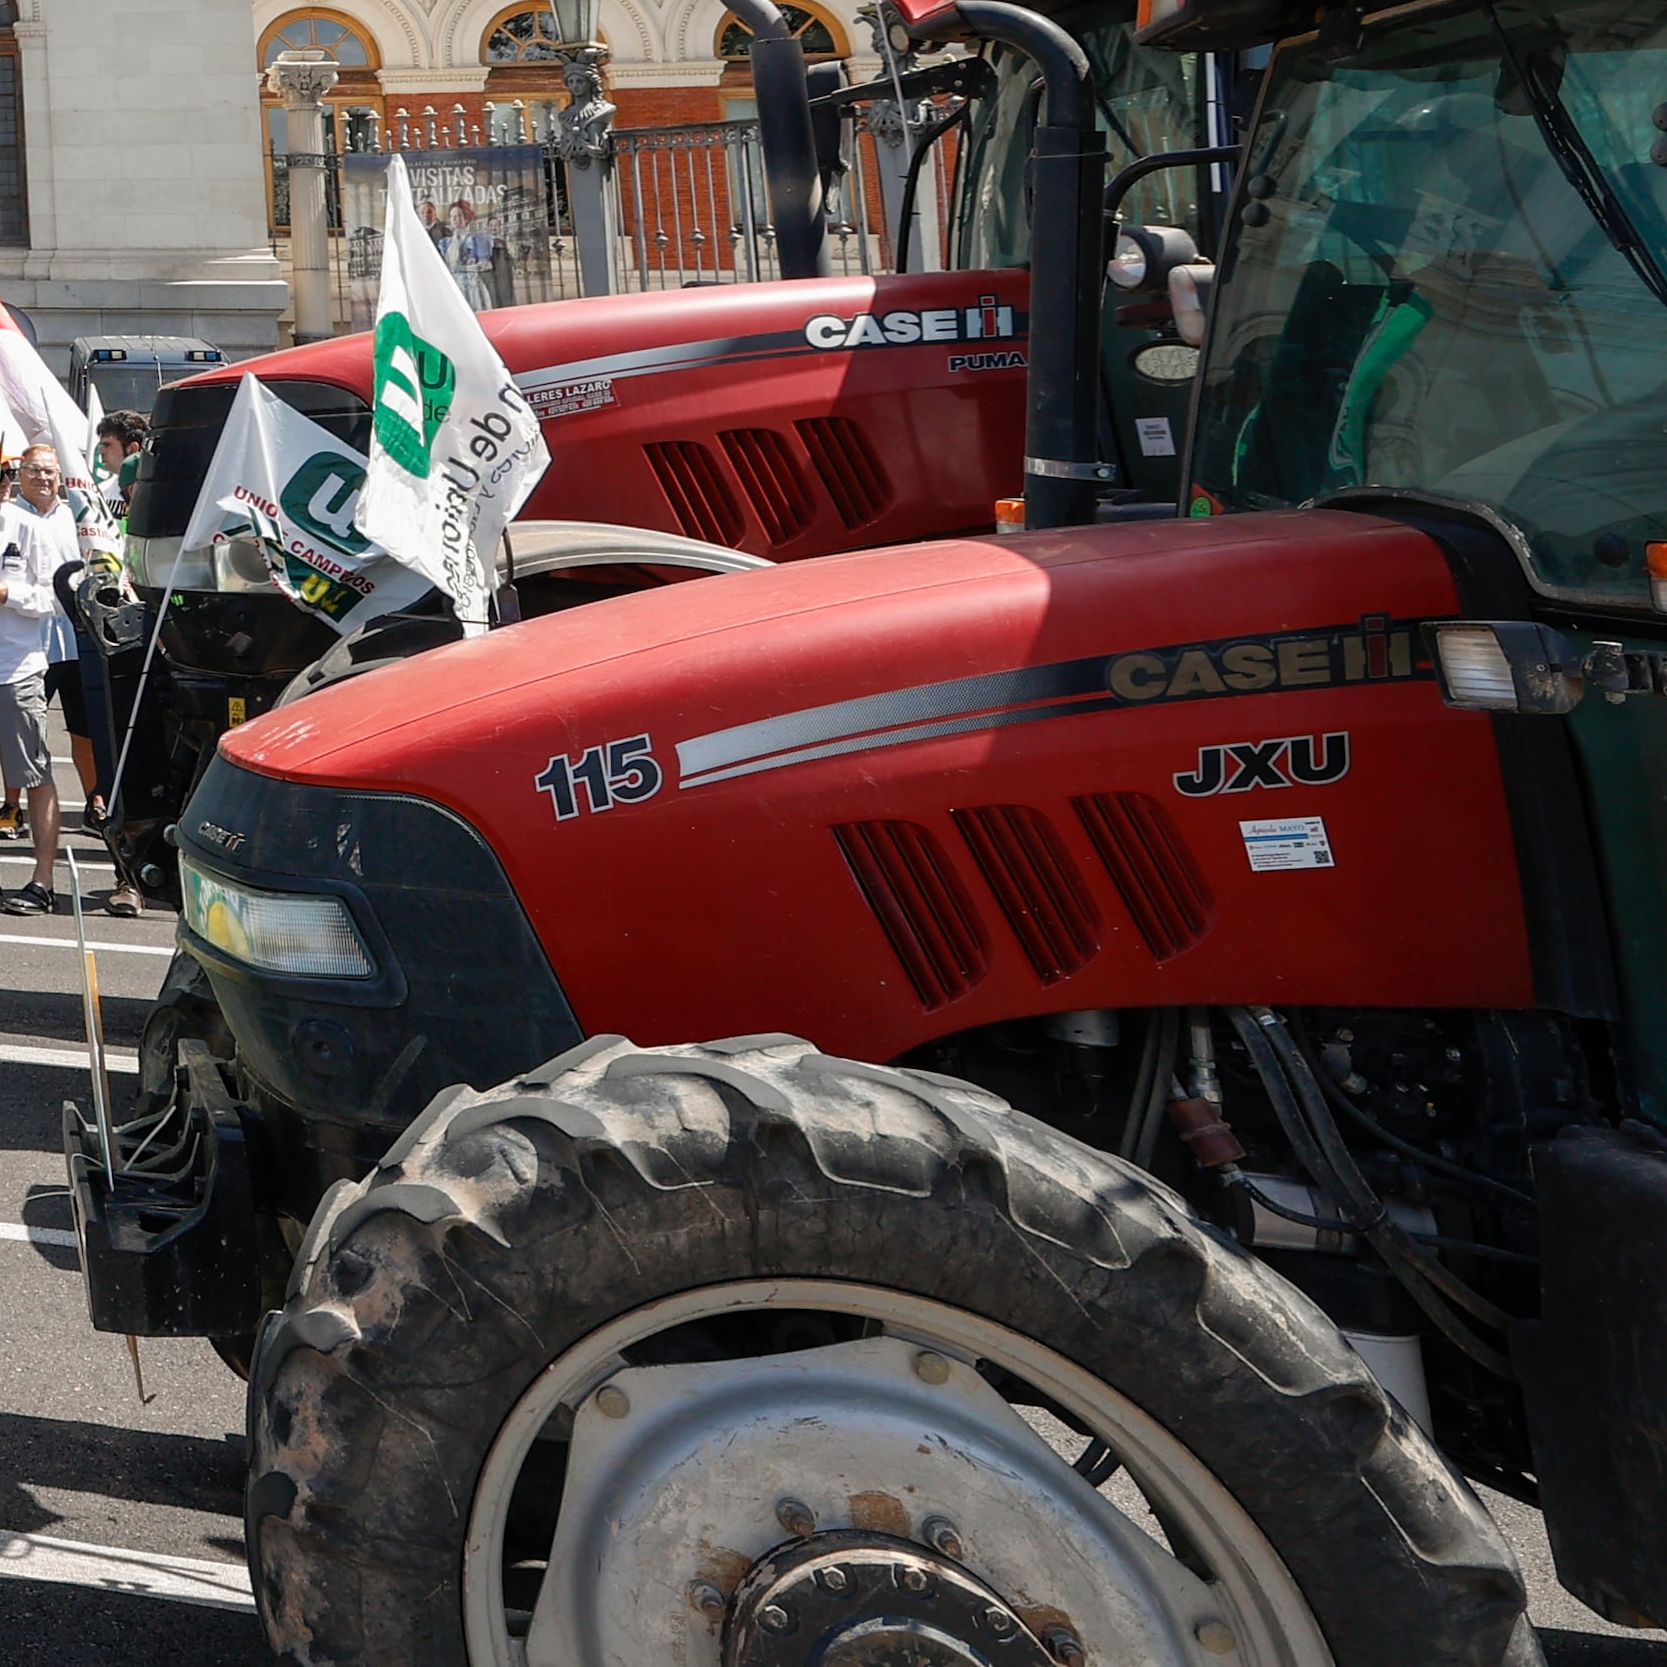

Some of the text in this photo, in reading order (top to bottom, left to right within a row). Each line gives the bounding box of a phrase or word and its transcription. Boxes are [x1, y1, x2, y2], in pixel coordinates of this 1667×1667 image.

[408, 166, 475, 187] VISITAS
[805, 309, 958, 349] CASE
[949, 351, 1029, 373] PUMA
[1109, 639, 1332, 701] CASE
[534, 733, 663, 822] 115
[1172, 730, 1351, 798] JXU
